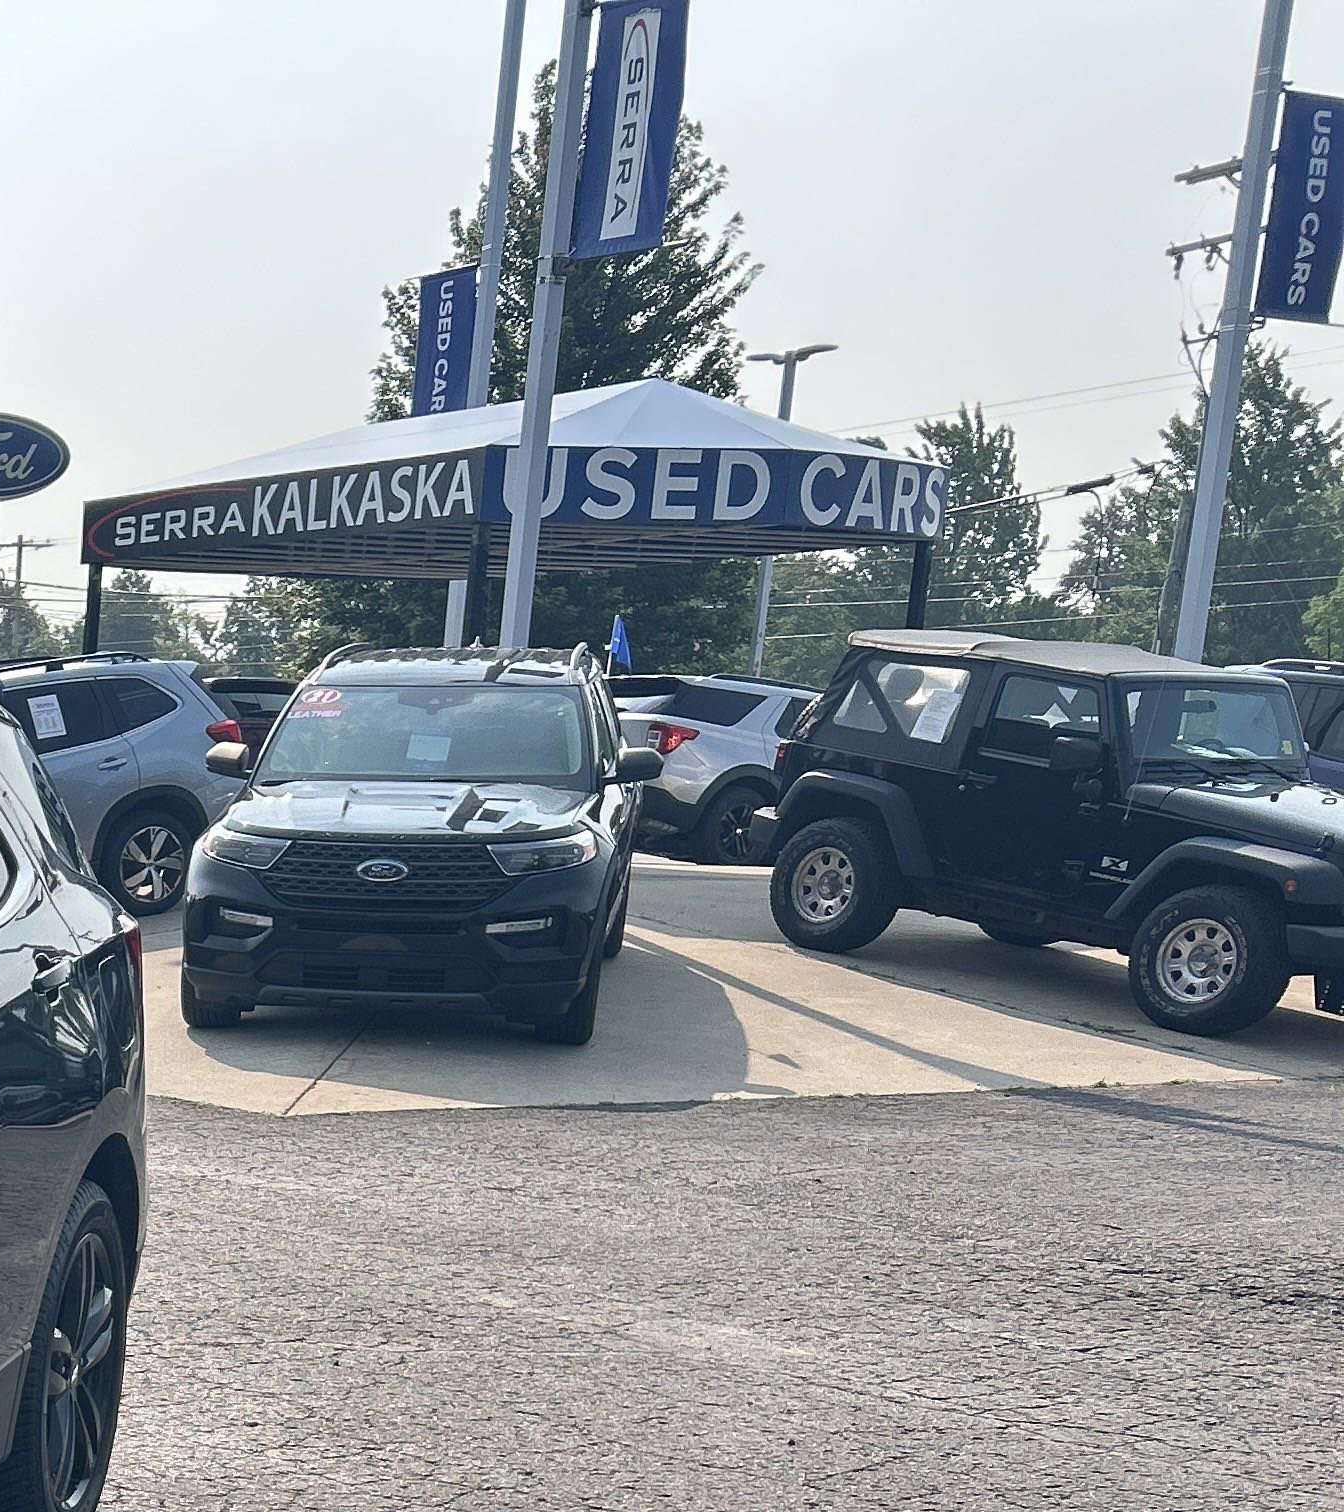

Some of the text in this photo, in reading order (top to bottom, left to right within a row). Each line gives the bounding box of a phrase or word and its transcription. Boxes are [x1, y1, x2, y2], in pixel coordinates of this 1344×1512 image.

[610, 56, 645, 224] SERRA
[1287, 110, 1333, 306] USED CARS
[429, 279, 454, 414] USED CAR
[114, 458, 475, 547] SERRA KALKASKA
[501, 446, 948, 538] USED CARS
